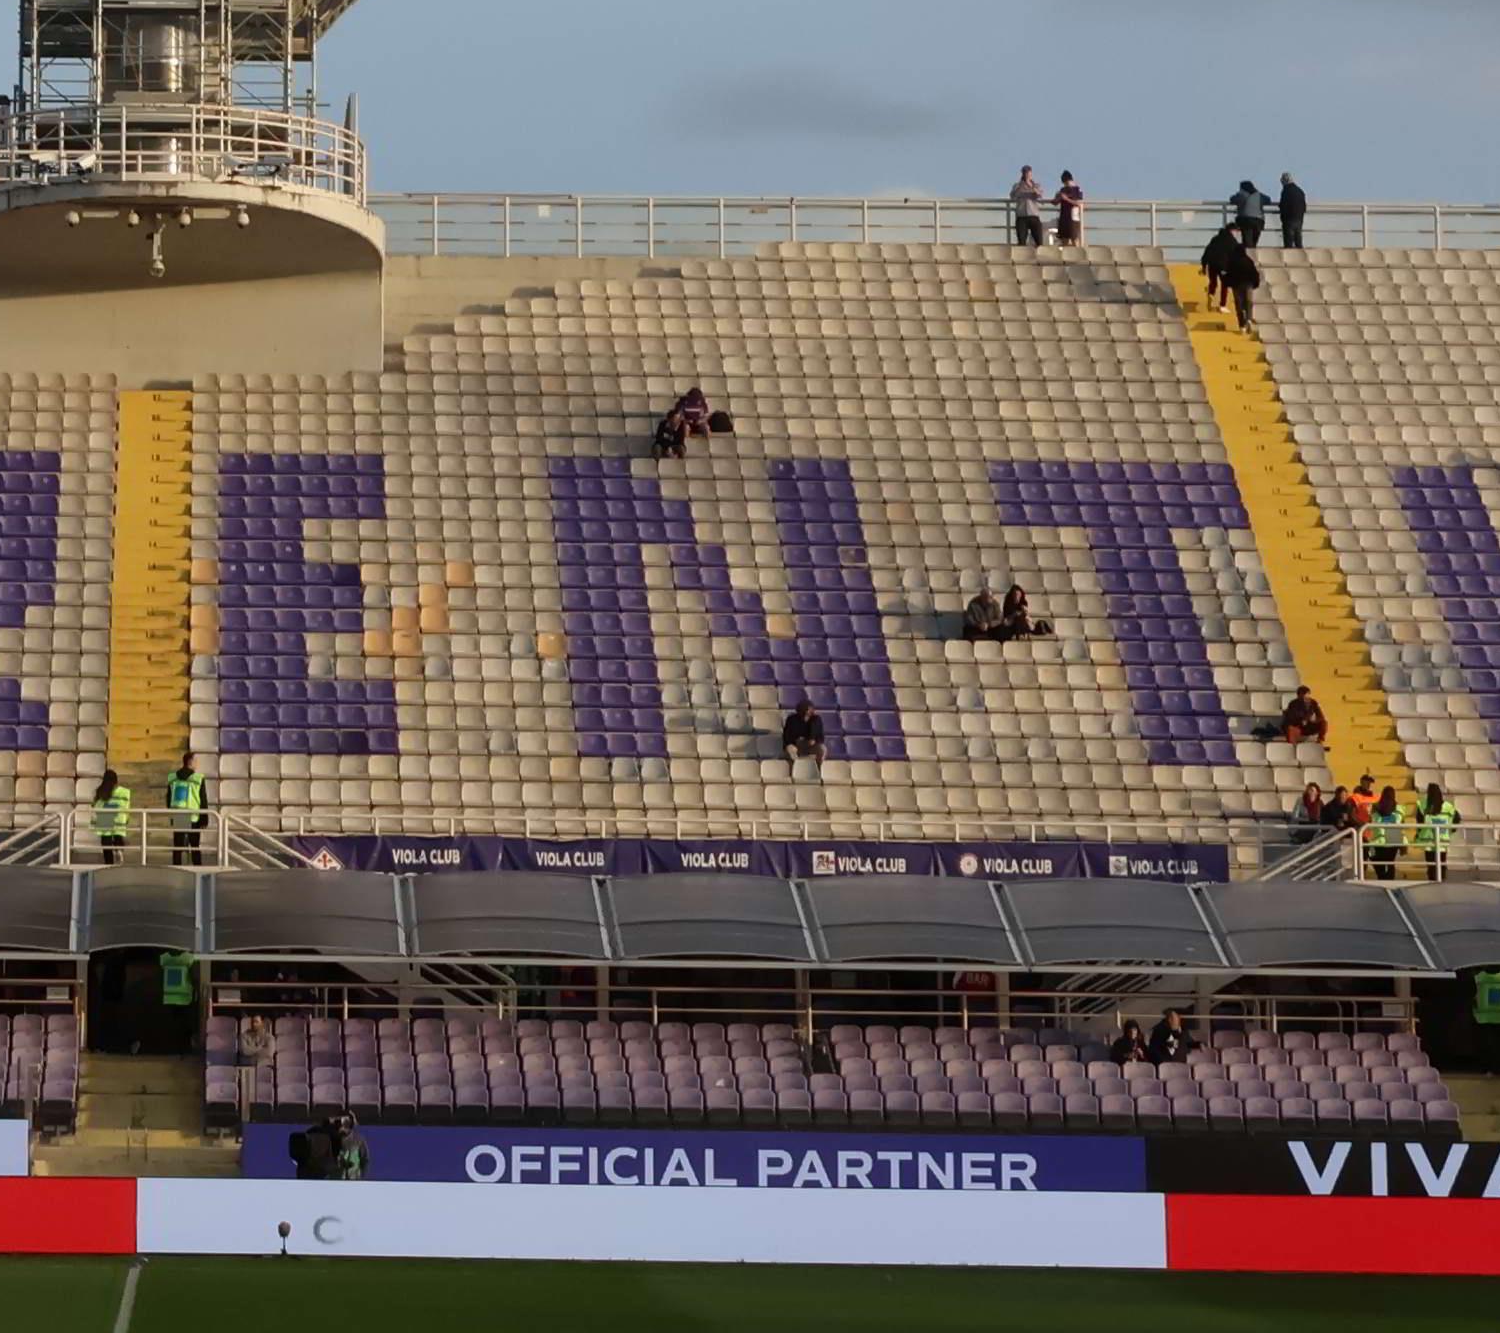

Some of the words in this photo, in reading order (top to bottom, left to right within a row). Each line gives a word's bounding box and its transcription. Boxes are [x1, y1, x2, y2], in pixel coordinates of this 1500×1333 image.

[392, 849, 427, 864] VIOLA
[430, 849, 460, 864] CLUB
[536, 851, 571, 867] VIOLA
[574, 851, 604, 867] CLUB
[681, 852, 715, 868] VIOLA
[719, 852, 749, 868] CLUB
[838, 856, 873, 873] VIOLA
[876, 856, 906, 873] CLUB
[984, 858, 1019, 874] VIOLA
[1022, 858, 1052, 874] CLUB
[1129, 859, 1164, 875] VIOLA
[1168, 859, 1198, 875] CLUB
[464, 1144, 737, 1186] OFFICIAL
[757, 1149, 1039, 1191] PARTNER
